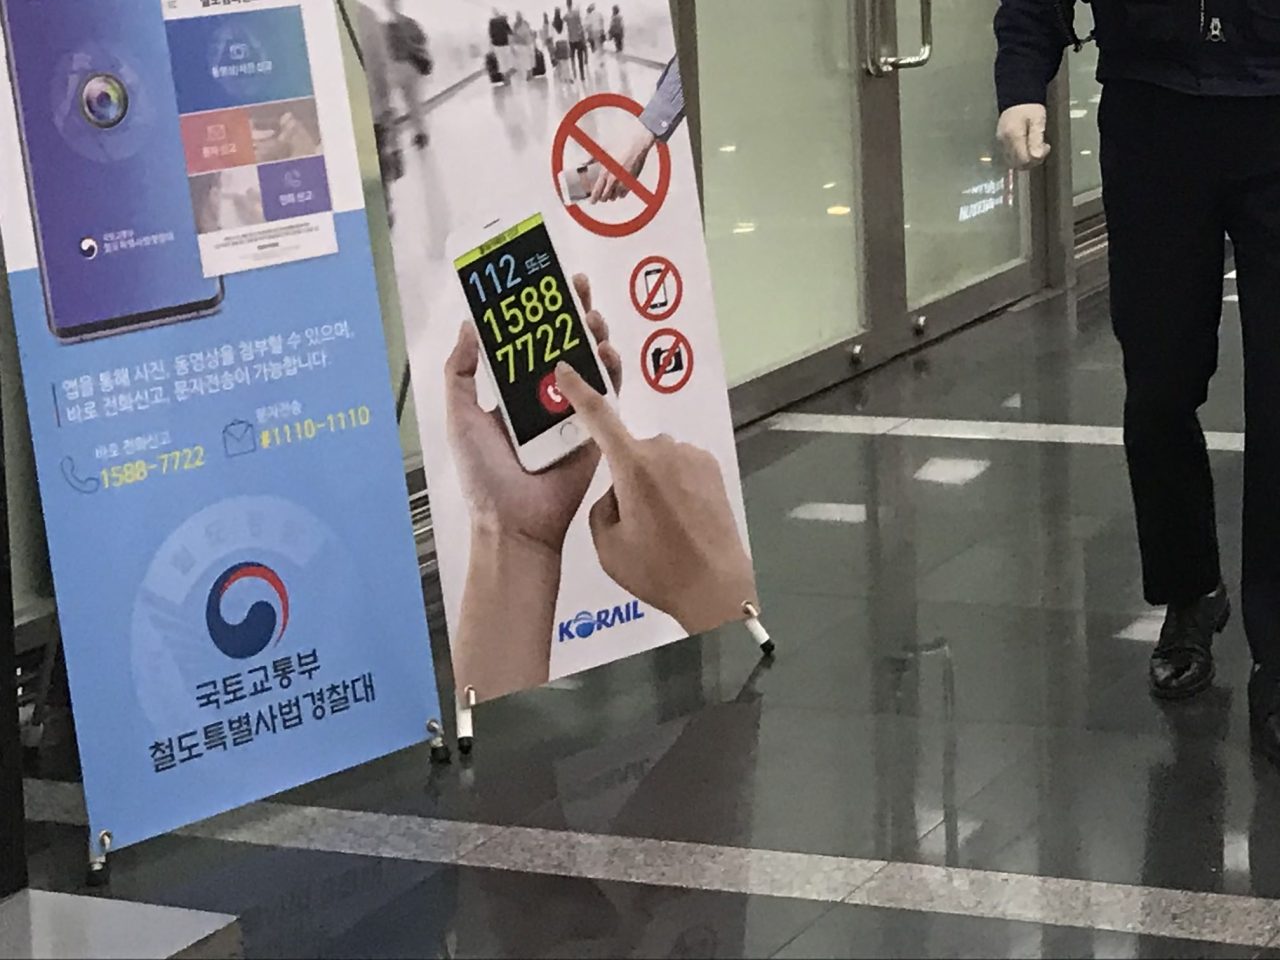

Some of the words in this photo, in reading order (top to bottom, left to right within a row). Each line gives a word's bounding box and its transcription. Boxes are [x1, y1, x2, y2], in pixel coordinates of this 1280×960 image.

[469, 253, 522, 303] 112
[525, 252, 551, 275] 또는
[483, 275, 563, 344] 1588
[99, 368, 131, 391] 통해
[174, 346, 235, 376] 동영상을
[239, 334, 283, 362] 첨부할
[287, 331, 301, 348] 수
[496, 312, 580, 384] 7722
[67, 400, 98, 423] 바로
[260, 405, 370, 449] #1110-1110
[101, 445, 205, 489] 1588-7722
[558, 600, 645, 642] KORAIL
[196, 648, 321, 709] 국토교통부
[149, 672, 376, 773] 철도특별사법경찰대
